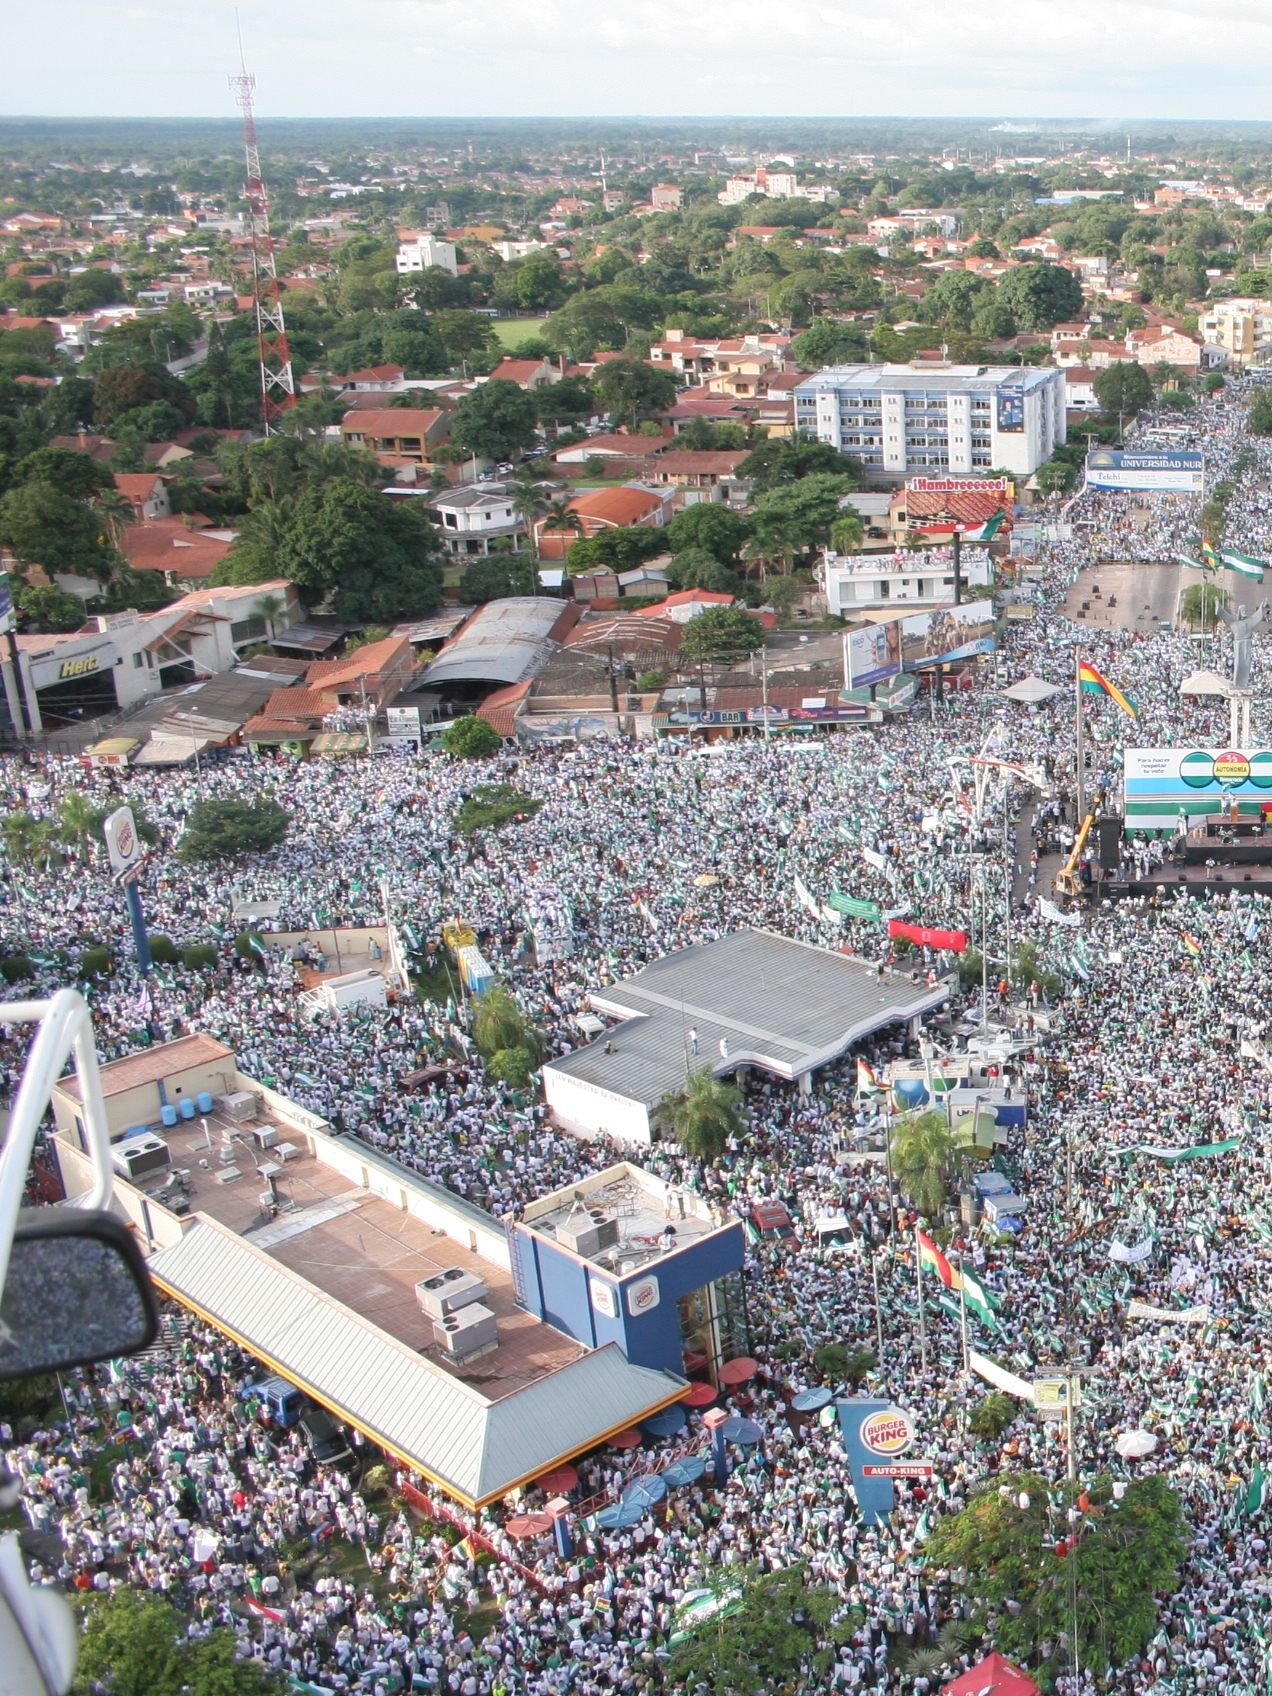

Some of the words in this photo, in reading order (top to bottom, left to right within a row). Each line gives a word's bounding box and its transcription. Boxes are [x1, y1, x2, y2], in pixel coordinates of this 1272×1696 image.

[1121, 460, 1181, 468] UNIVERSIDAD
[1183, 460, 1202, 469] NUR
[60, 655, 101, 679] Hertz
[722, 712, 739, 722] BAR
[867, 1419, 906, 1436] BURGER
[870, 1427, 907, 1446] KING
[871, 1467, 926, 1475] AUTO-KING
